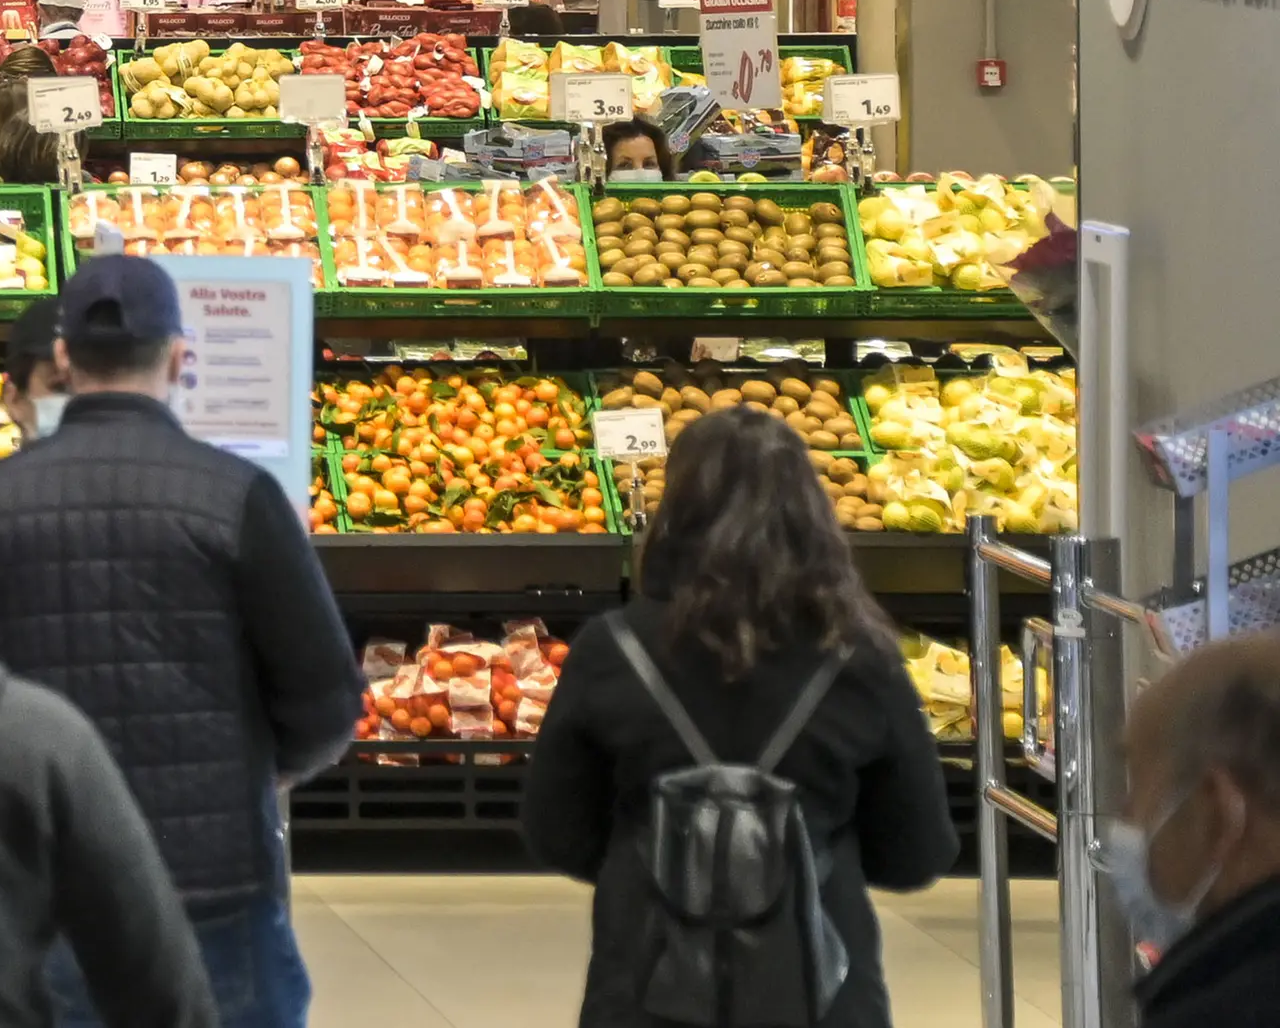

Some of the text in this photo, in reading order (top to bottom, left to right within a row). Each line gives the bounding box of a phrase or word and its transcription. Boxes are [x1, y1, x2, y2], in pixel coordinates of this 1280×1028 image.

[63, 106, 92, 124] 2,49
[593, 99, 624, 117] 3,98
[861, 99, 890, 116] 1,49
[150, 171, 170, 183] 1,29
[190, 289, 266, 301] Alla Vostra
[625, 435, 656, 452] 2,99
